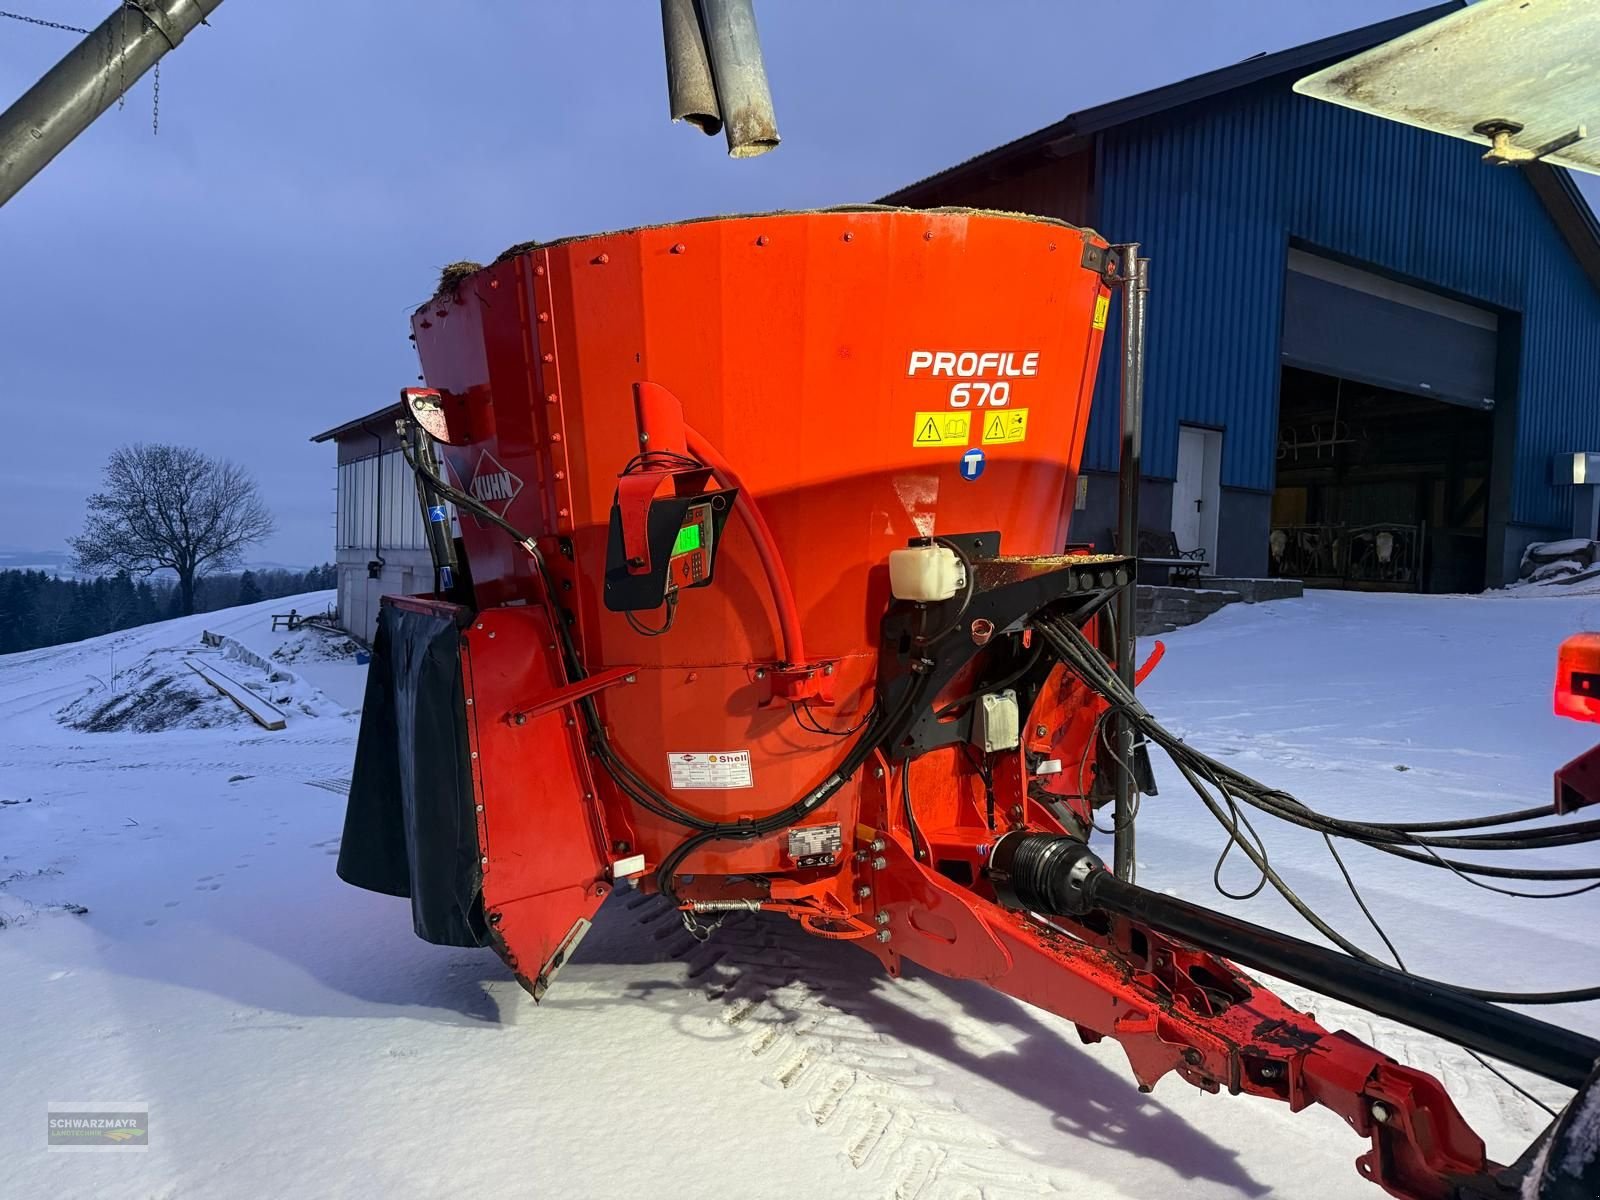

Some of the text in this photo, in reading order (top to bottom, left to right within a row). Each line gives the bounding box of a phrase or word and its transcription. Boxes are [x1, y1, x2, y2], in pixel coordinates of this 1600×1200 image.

[908, 351, 1039, 376] PROFILE
[950, 382, 1010, 408] 670
[475, 471, 514, 501] KUHN
[719, 754, 747, 763] Shell
